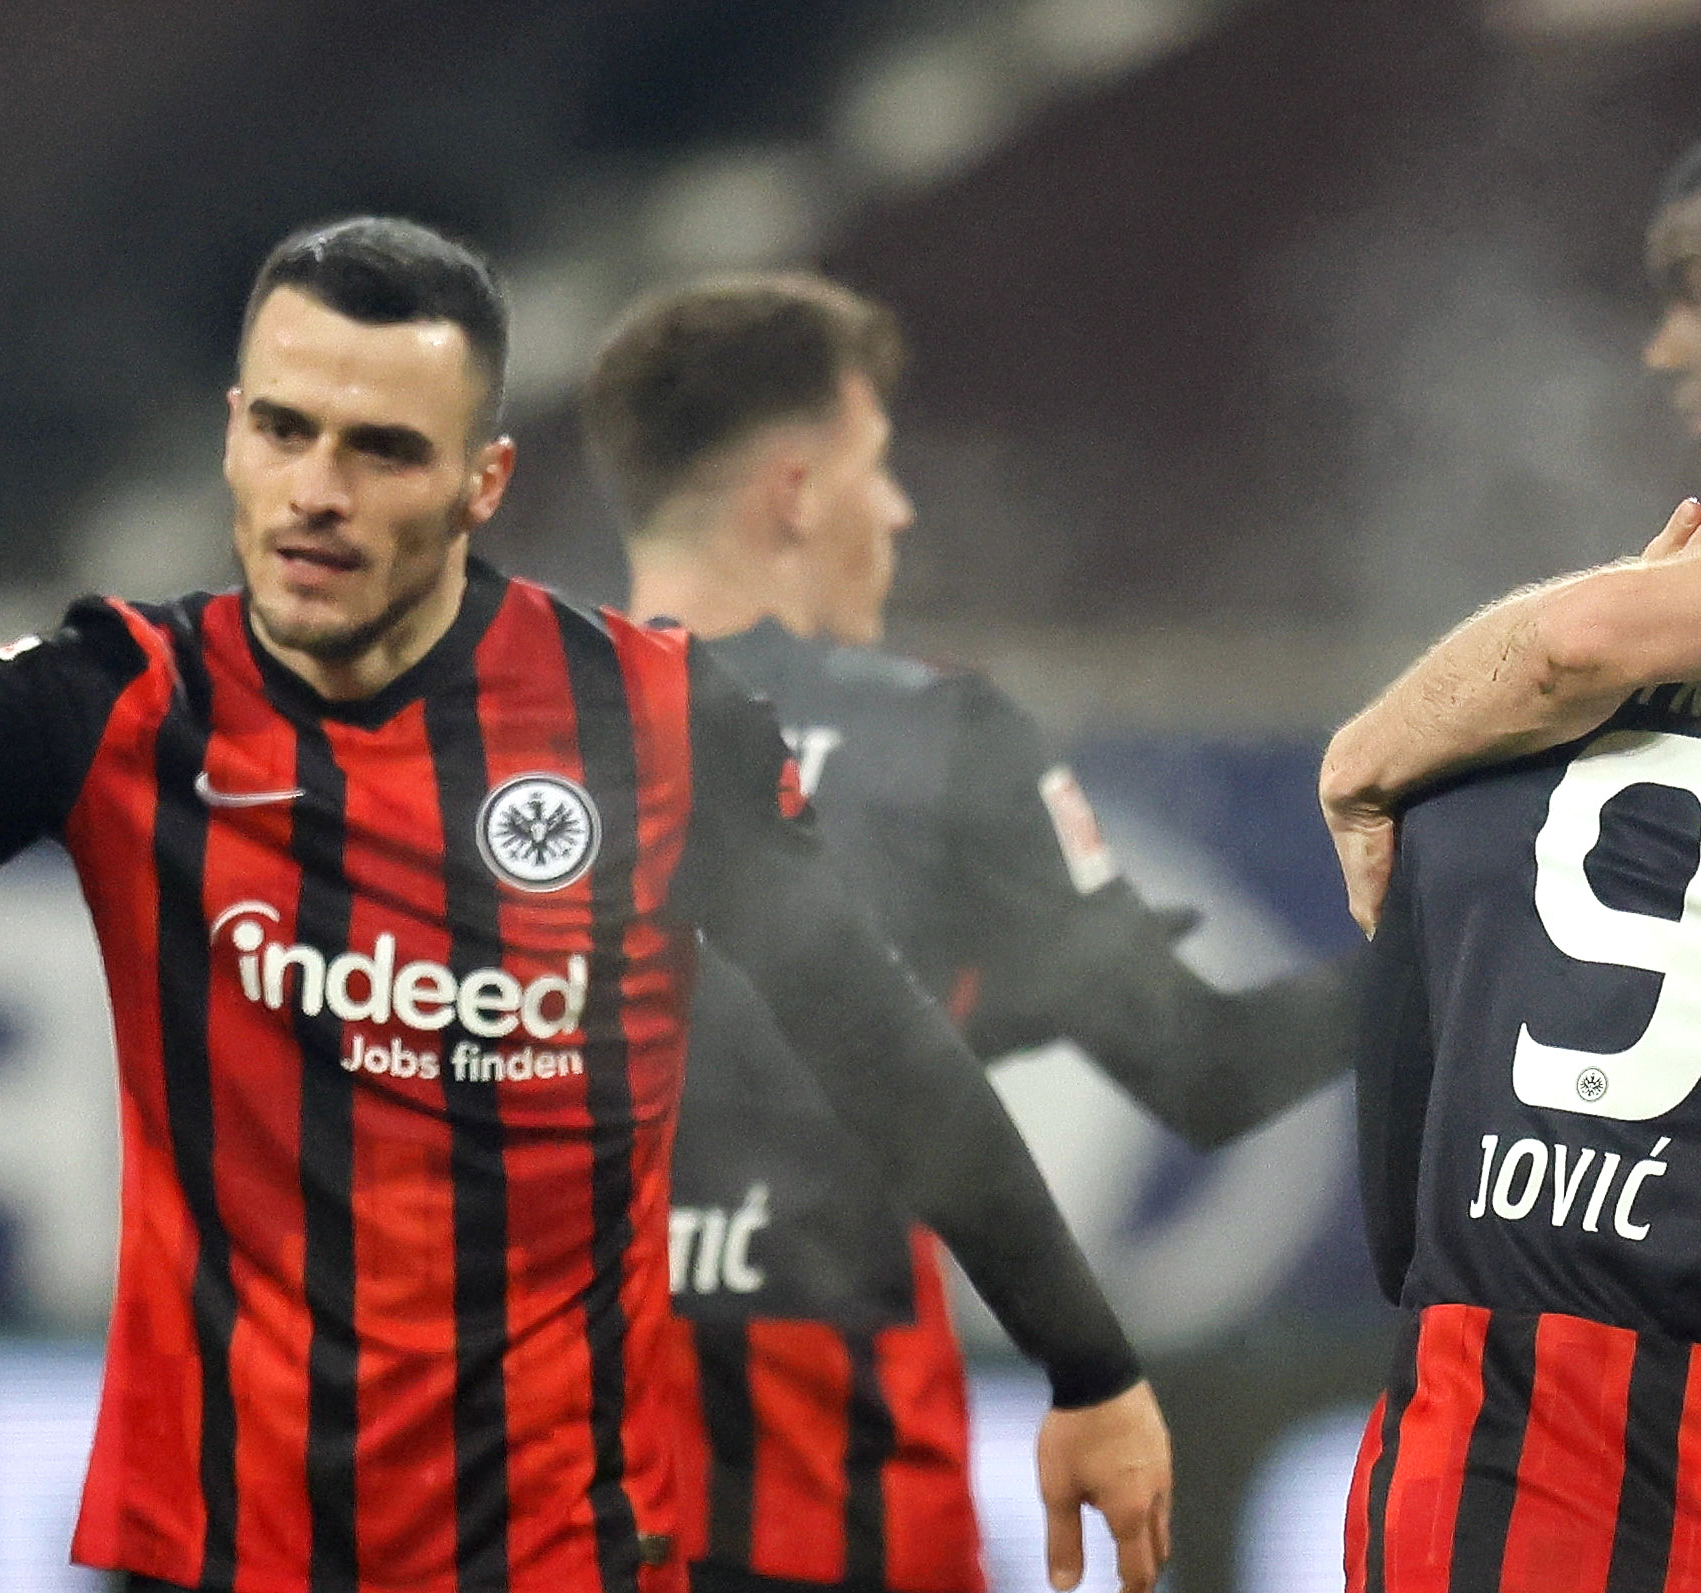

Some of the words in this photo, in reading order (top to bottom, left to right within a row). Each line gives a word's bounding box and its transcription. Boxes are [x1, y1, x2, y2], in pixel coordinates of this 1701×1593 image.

[216, 903, 588, 1039] indeed
[341, 1036, 440, 1080] Jobs
[451, 1043, 584, 1084] finden
[1469, 1133, 1670, 1242] JOVIĆ
